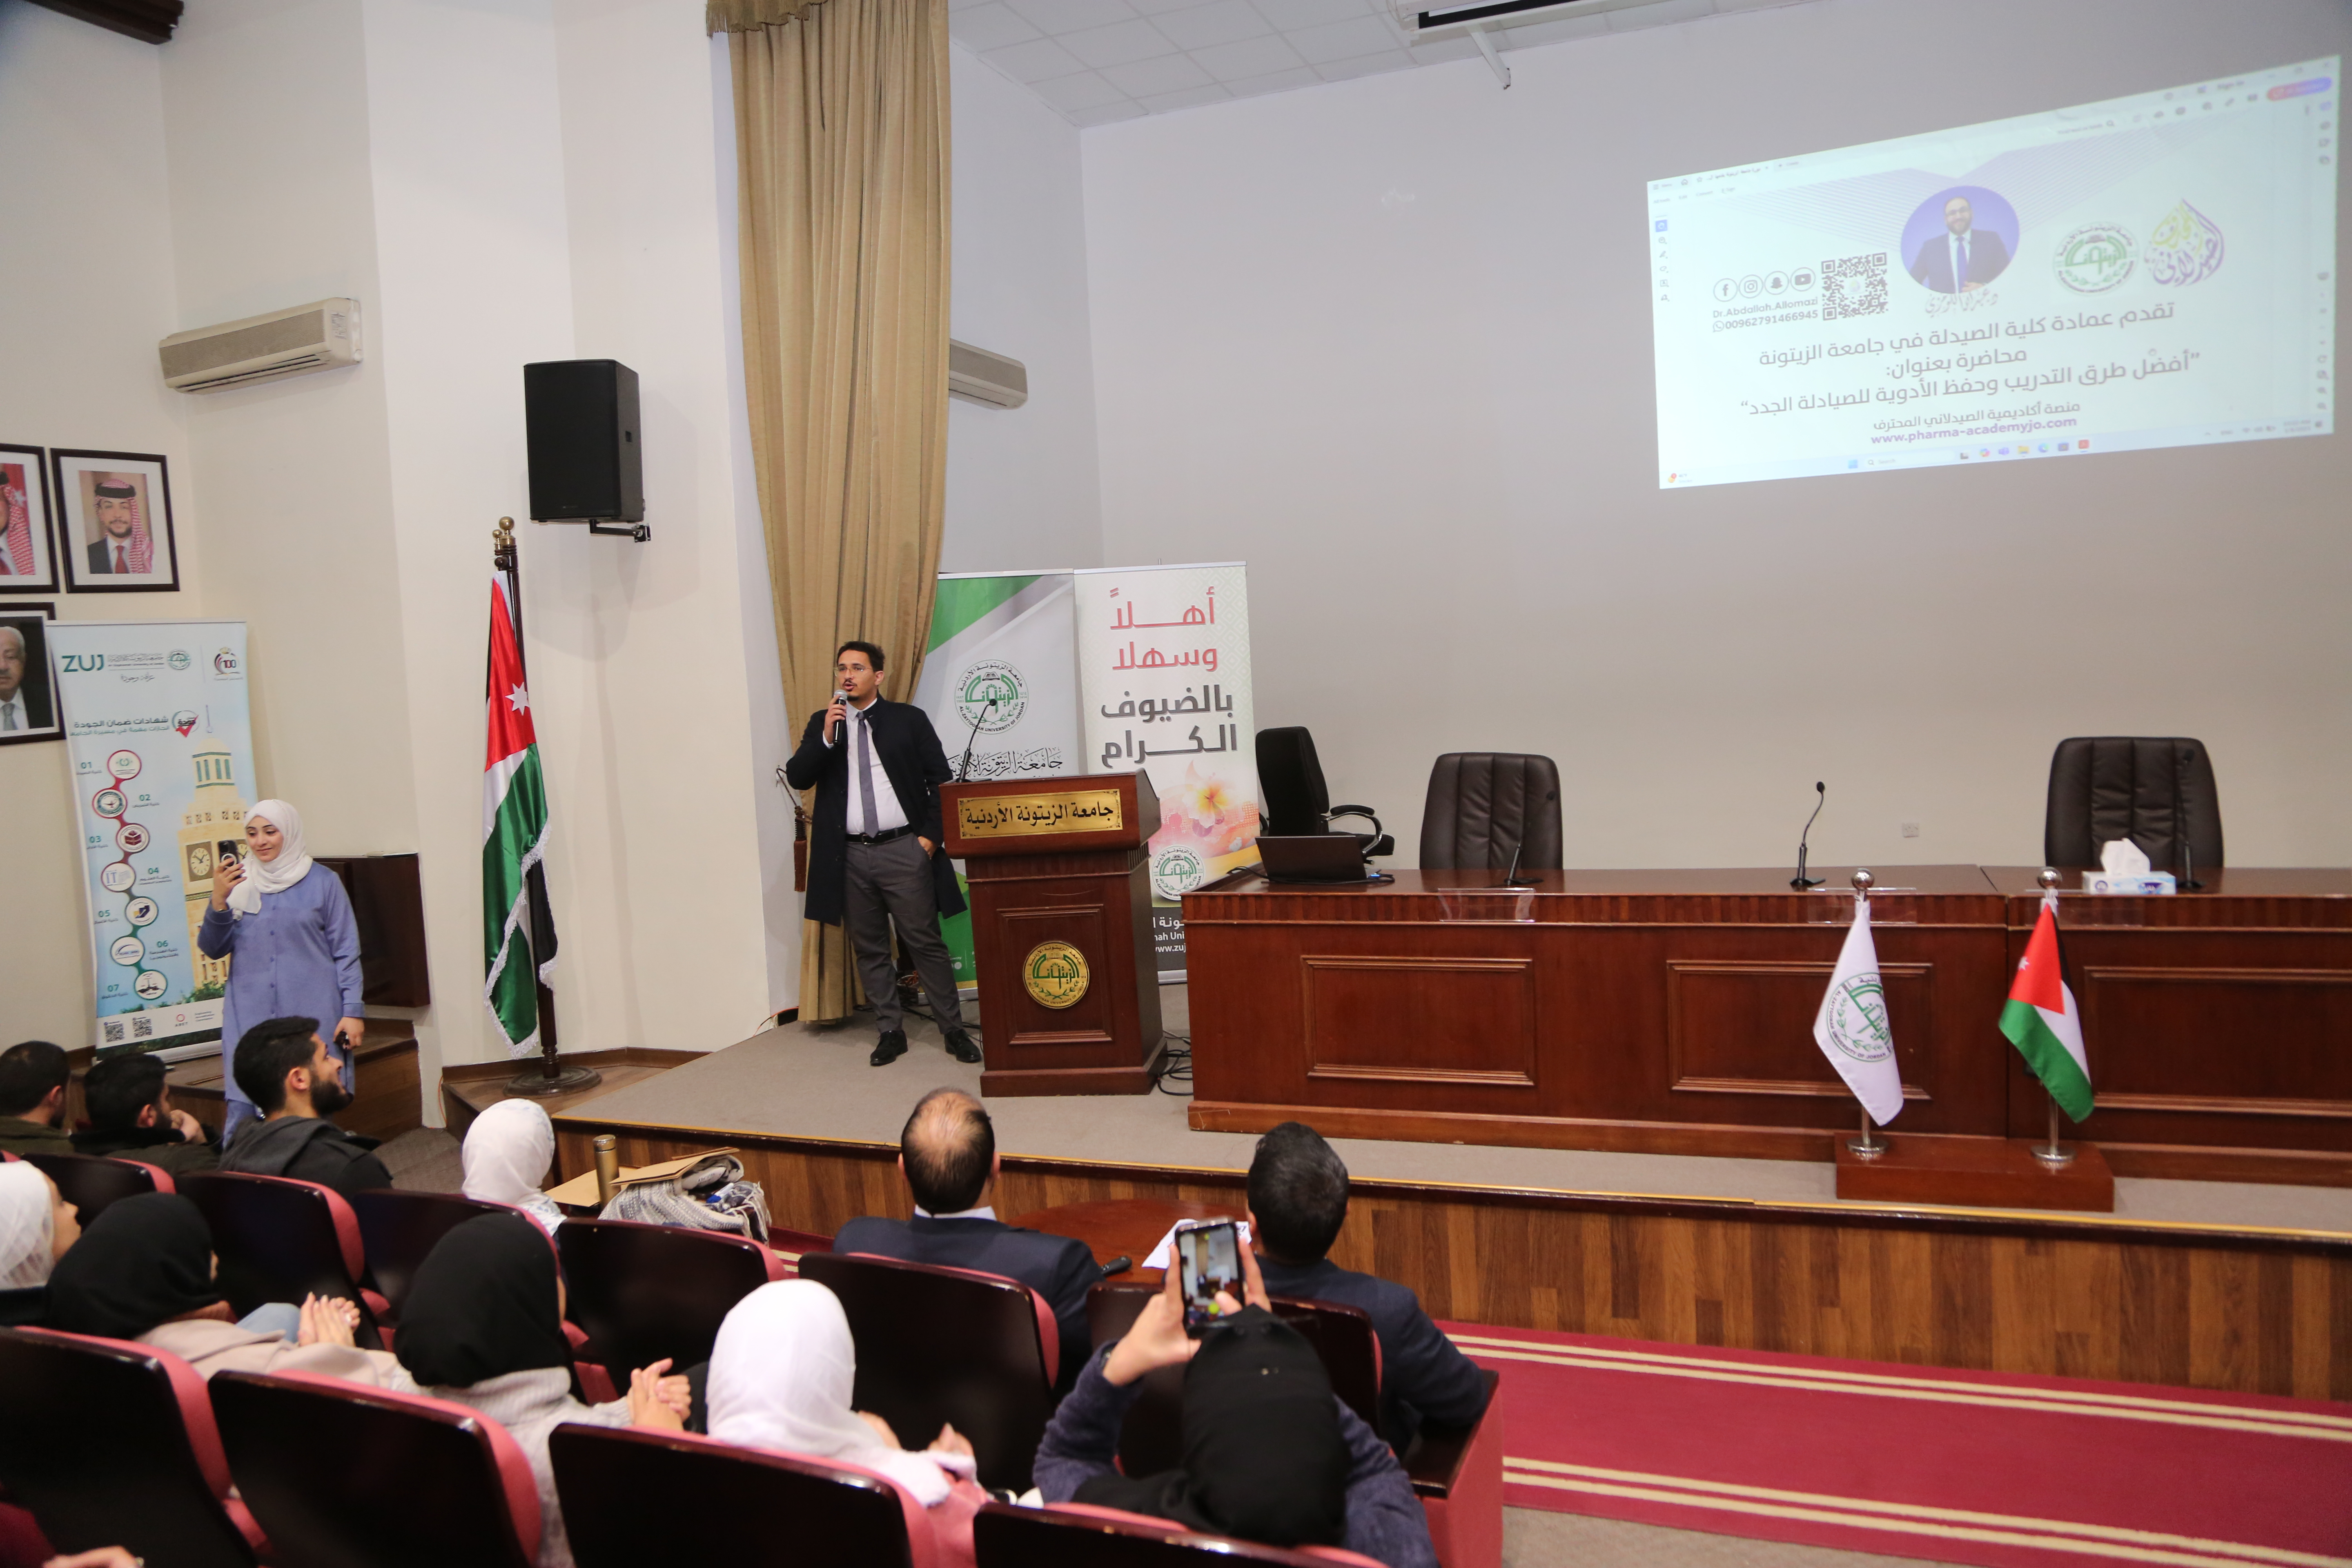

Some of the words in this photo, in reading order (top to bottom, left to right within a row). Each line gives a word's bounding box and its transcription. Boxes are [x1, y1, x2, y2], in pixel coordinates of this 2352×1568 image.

[1713, 296, 1818, 318] Dr.Abdallah.Allomazi
[2120, 302, 2175, 328] تقدم
[1725, 310, 1818, 330] 00962791466945
[2005, 317, 2047, 339] كلية
[2051, 312, 2114, 331] عمادة
[1890, 332, 1923, 354] في
[1929, 322, 1999, 346] الصيدلة
[1759, 344, 1822, 368] الزيتونة
[1828, 338, 1884, 357] جامعة
[1956, 349, 2027, 372] محاضرة
[2005, 367, 2071, 392] التدريب
[2078, 362, 2127, 386] طرق
[1876, 377, 1938, 405] الأدوية
[1942, 378, 1998, 395] وحفظ
[1798, 388, 1869, 410] للصيادلة
[2044, 403, 2080, 414] منصة
[1924, 411, 1984, 427] الصيدلاني
[1987, 401, 2041, 420] أكاديمية
[1871, 416, 2077, 443] www.pharma-academyjo.com
[1873, 416, 1921, 432] المحترف
[1109, 586, 1216, 630] أهلاً
[62, 654, 105, 672] ZUJ
[975, 662, 1009, 671] الزيتونة
[1112, 641, 1218, 672] وسهلا
[1008, 667, 1022, 688] جامعة
[1016, 702, 1025, 721] JORDAN
[1101, 684, 1234, 723] بالضيوف
[74, 720, 105, 728] الجودة
[107, 719, 131, 727] ضمان
[133, 715, 169, 725] شهادات
[1101, 723, 1238, 769] الكرام
[965, 802, 1013, 829] الأردنية
[1016, 804, 1068, 826] الزيتونة
[1071, 801, 1114, 821] جامعة
[106, 872, 117, 884] IT
[107, 984, 120, 992] 07
[1029, 982, 1050, 1003] AL-ZAYTOONAH
